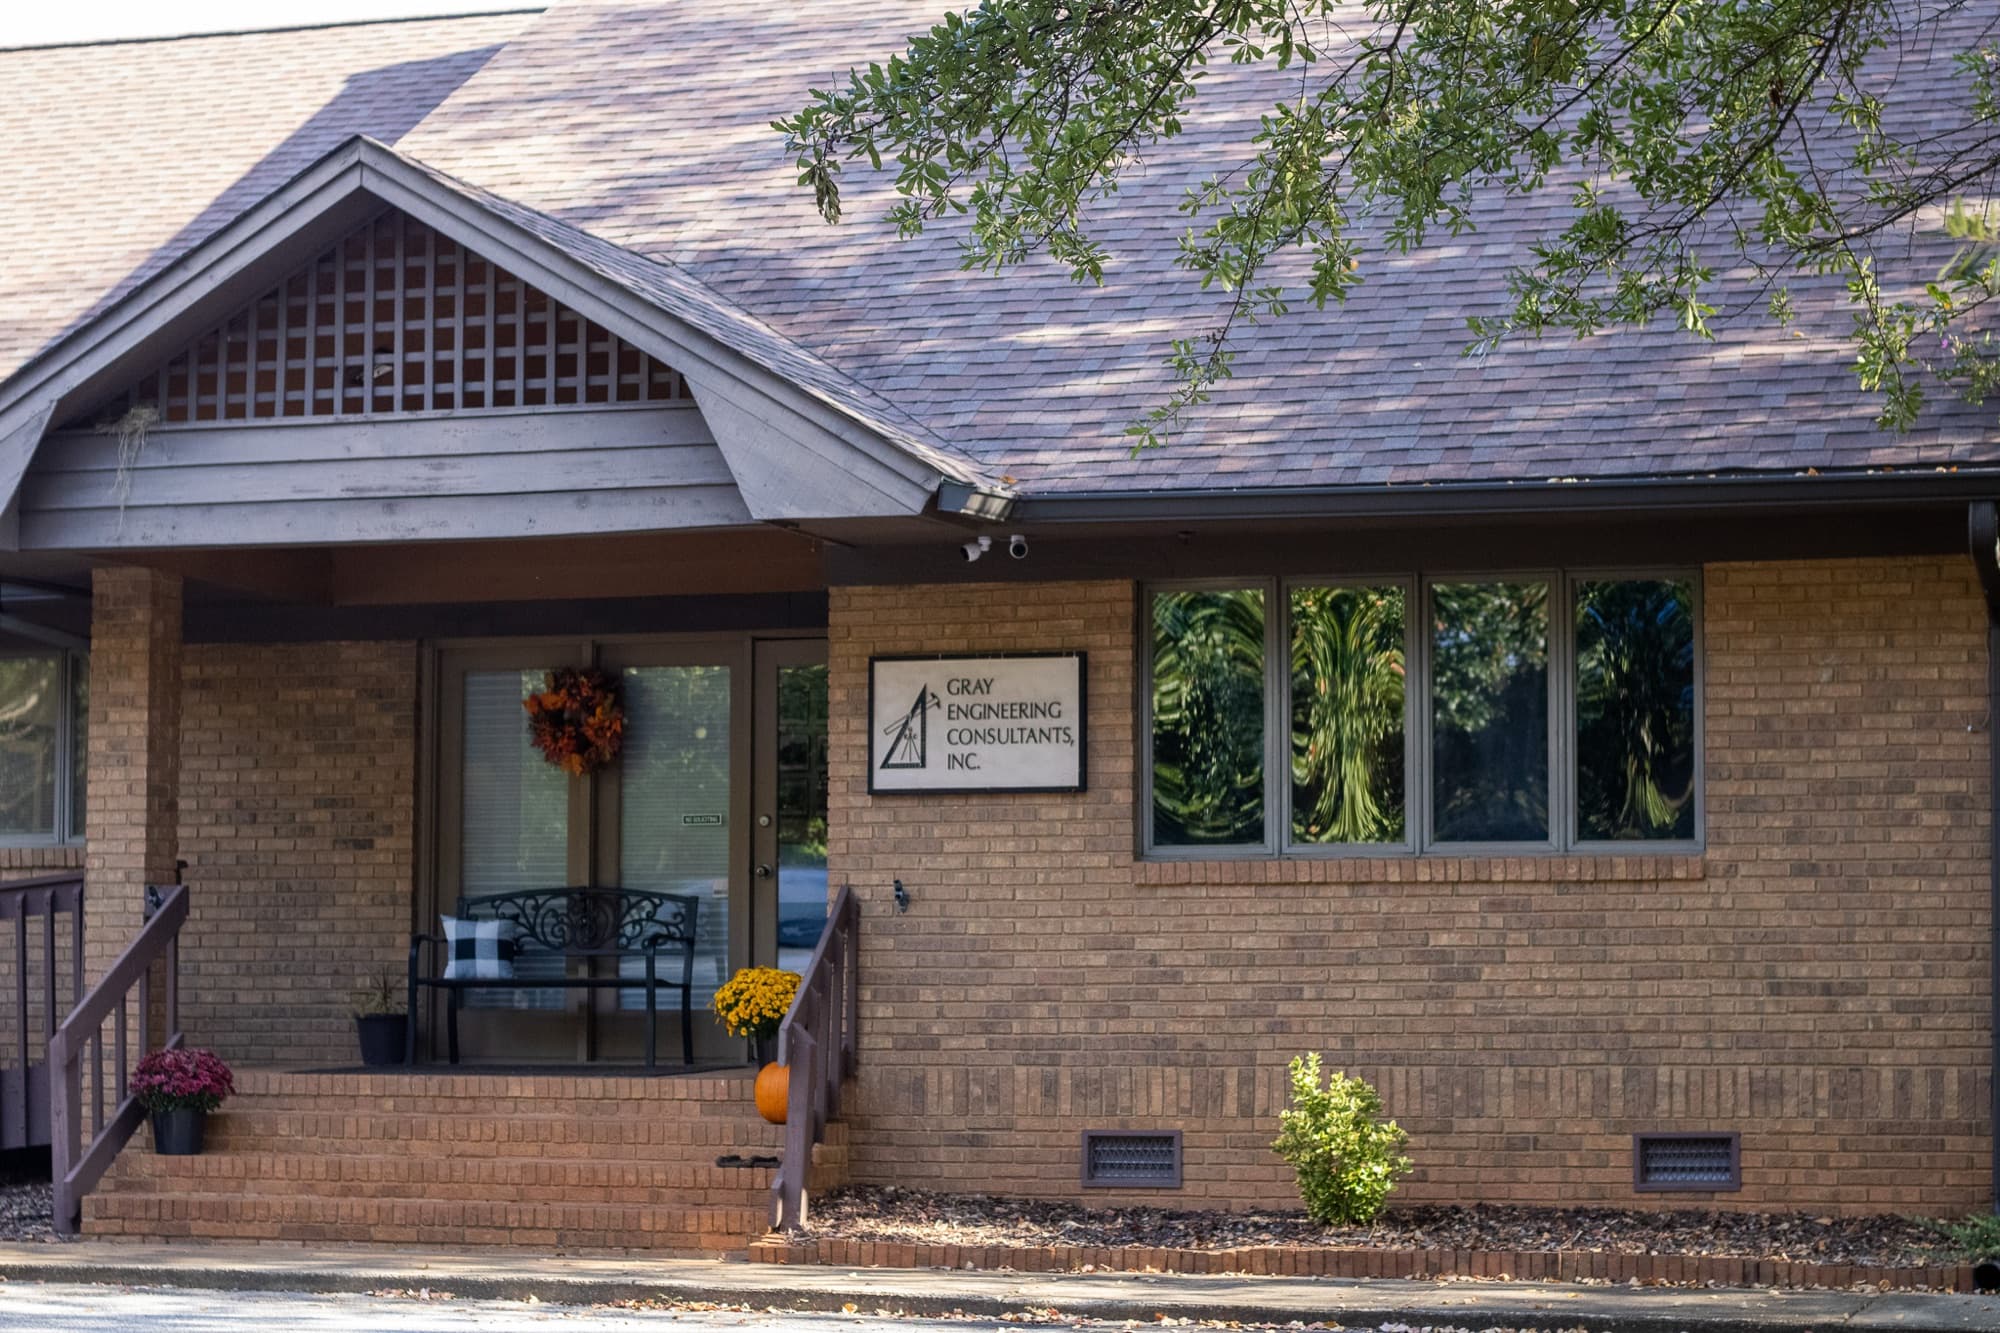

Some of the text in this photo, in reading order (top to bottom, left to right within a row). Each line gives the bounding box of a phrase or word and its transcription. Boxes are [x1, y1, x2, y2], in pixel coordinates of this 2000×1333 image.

[946, 678, 995, 696] GRAY
[947, 701, 1062, 721] ENGINEERING
[946, 726, 1075, 747] CONSULTANTS,
[947, 752, 981, 770] INC.
